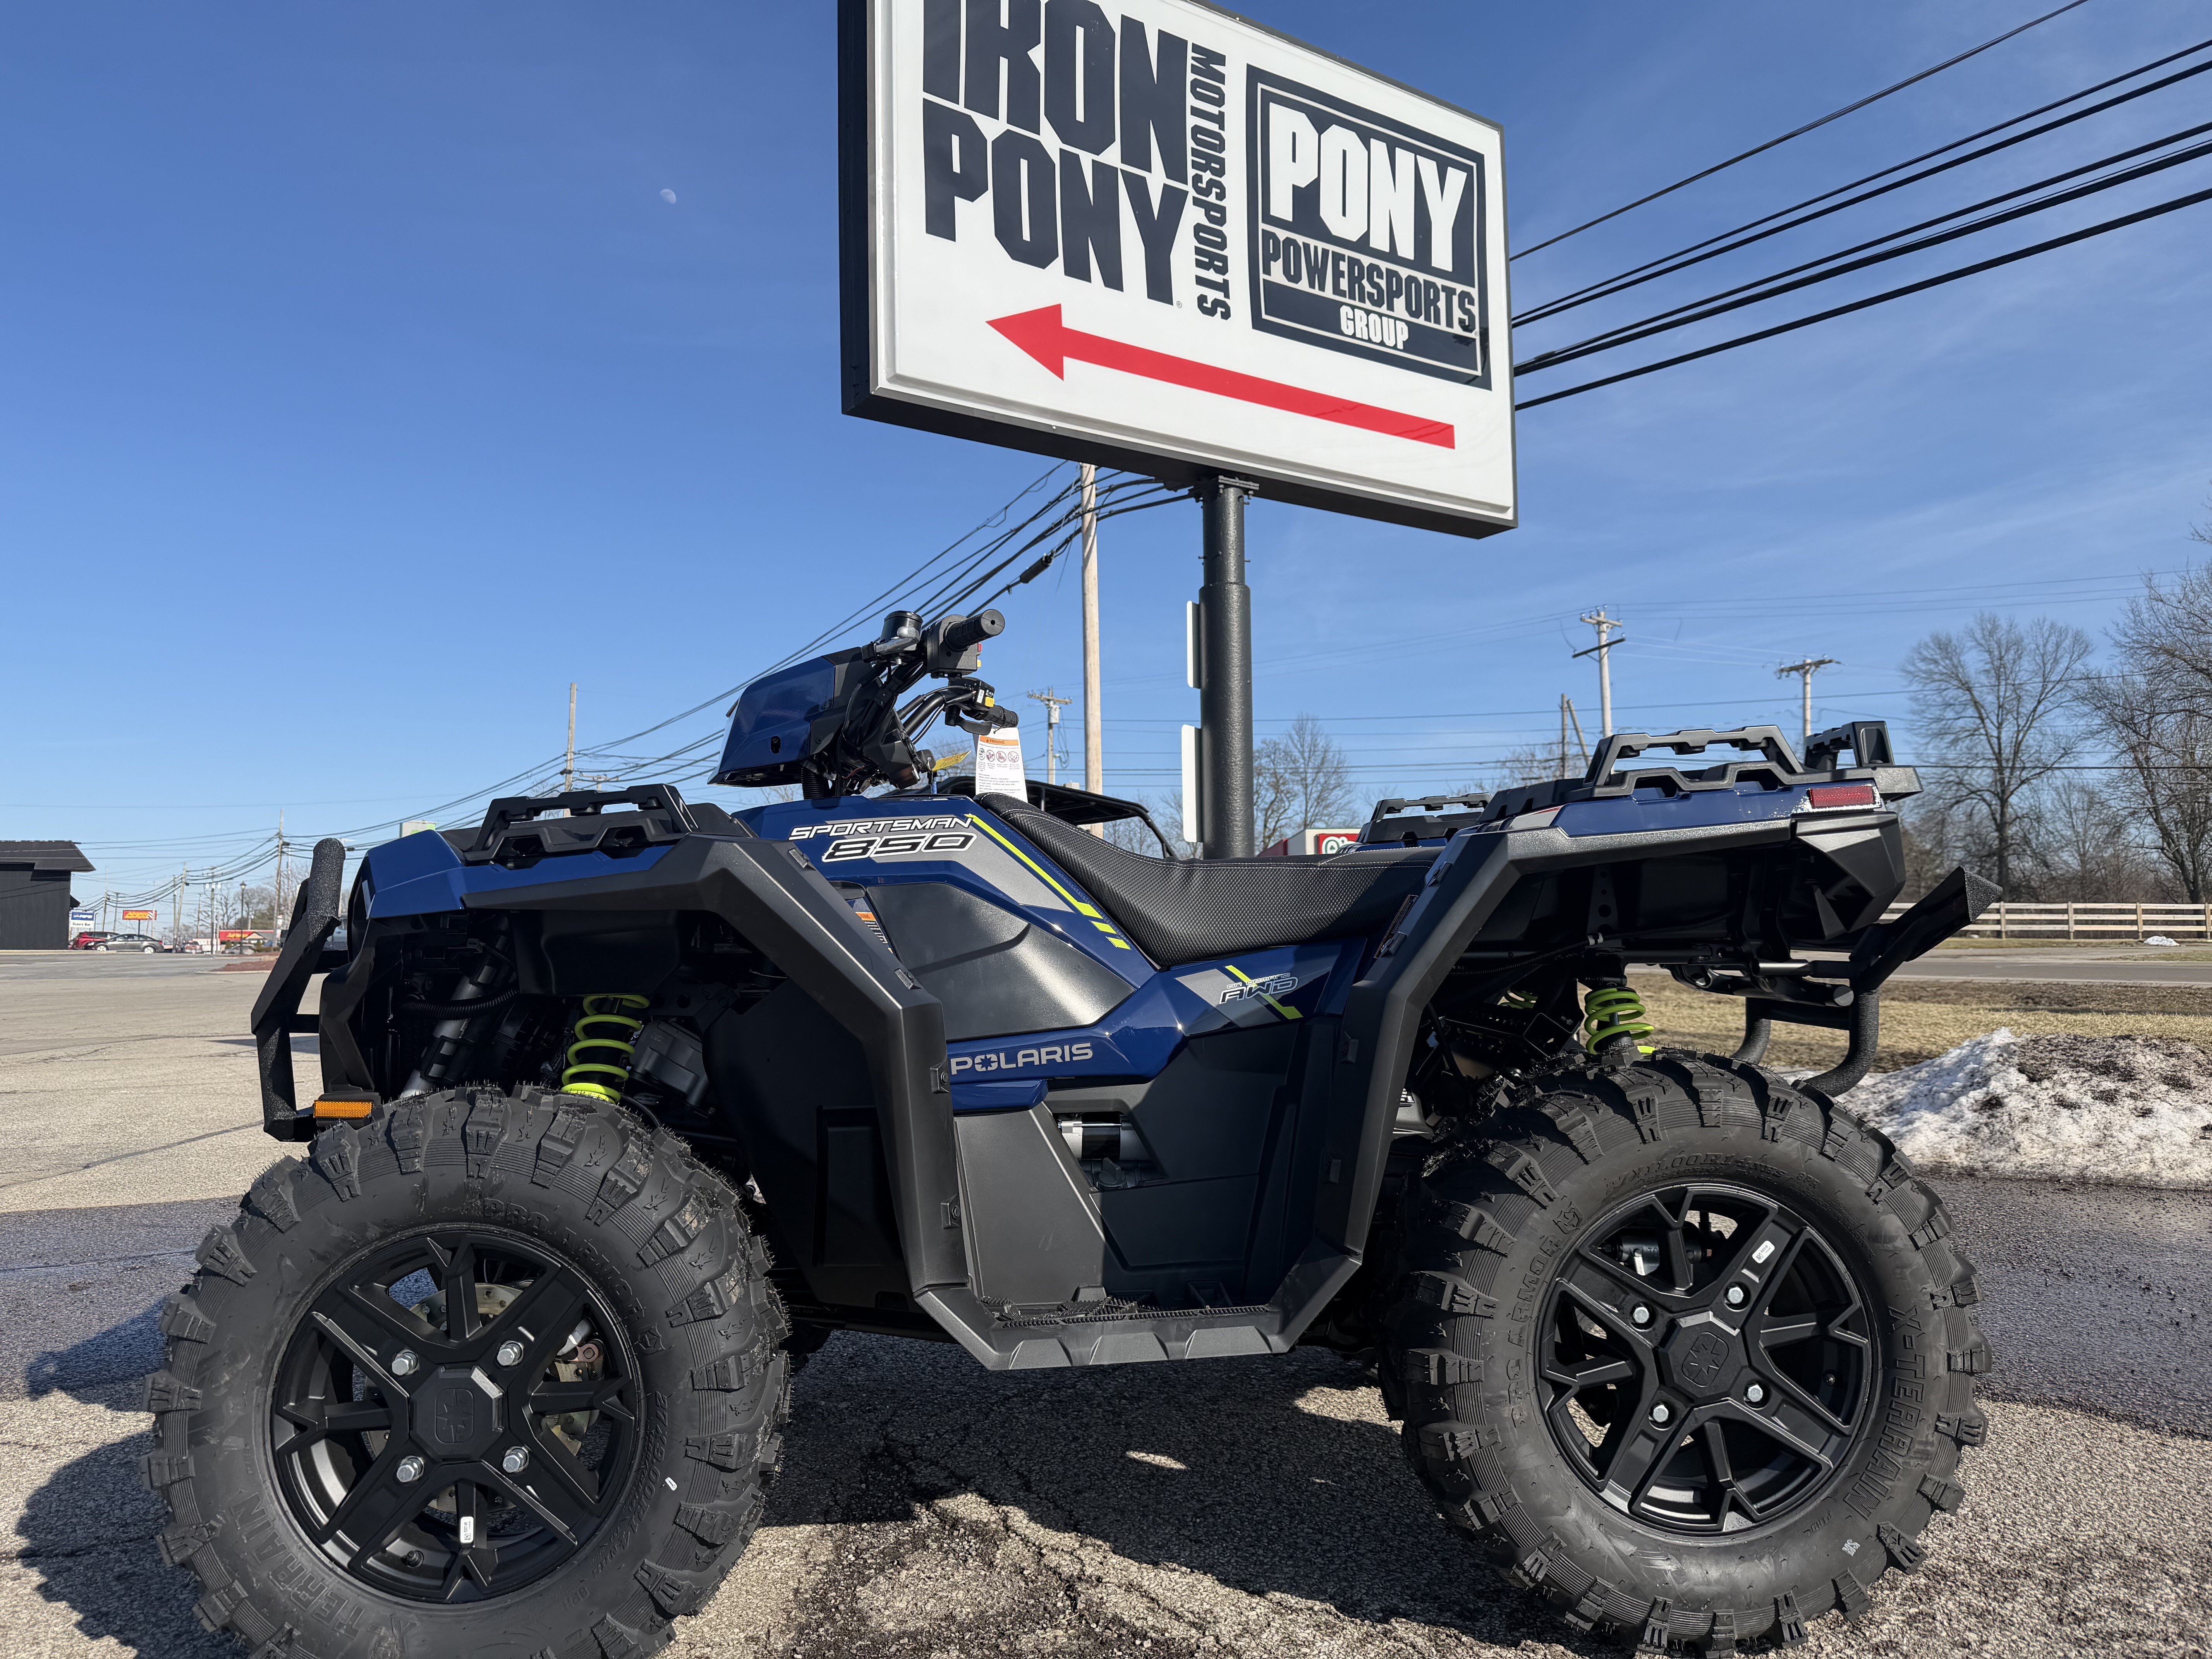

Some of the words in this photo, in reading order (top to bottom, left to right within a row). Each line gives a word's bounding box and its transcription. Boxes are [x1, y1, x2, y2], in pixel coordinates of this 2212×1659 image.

[923, 0, 1188, 186] IRON
[923, 98, 1190, 306] PONY
[1190, 43, 1231, 321] MOTORSPORTS
[1269, 102, 1467, 272] PONY
[1262, 229, 1477, 335] POWERSPORTS
[1340, 306, 1409, 350] GROUP
[789, 816, 972, 840] SPORTSMAN
[822, 831, 977, 862] 850
[1219, 977, 1298, 1004] AWD
[1246, 973, 1290, 985] DEMAND
[950, 1042, 1093, 1075] POLARIS
[483, 1197, 550, 1232] PRO
[562, 1226, 646, 1321] ARMOR
[1843, 1306, 1926, 1521] X-TERRAIN
[229, 1491, 420, 1654] X-TERRAIN
